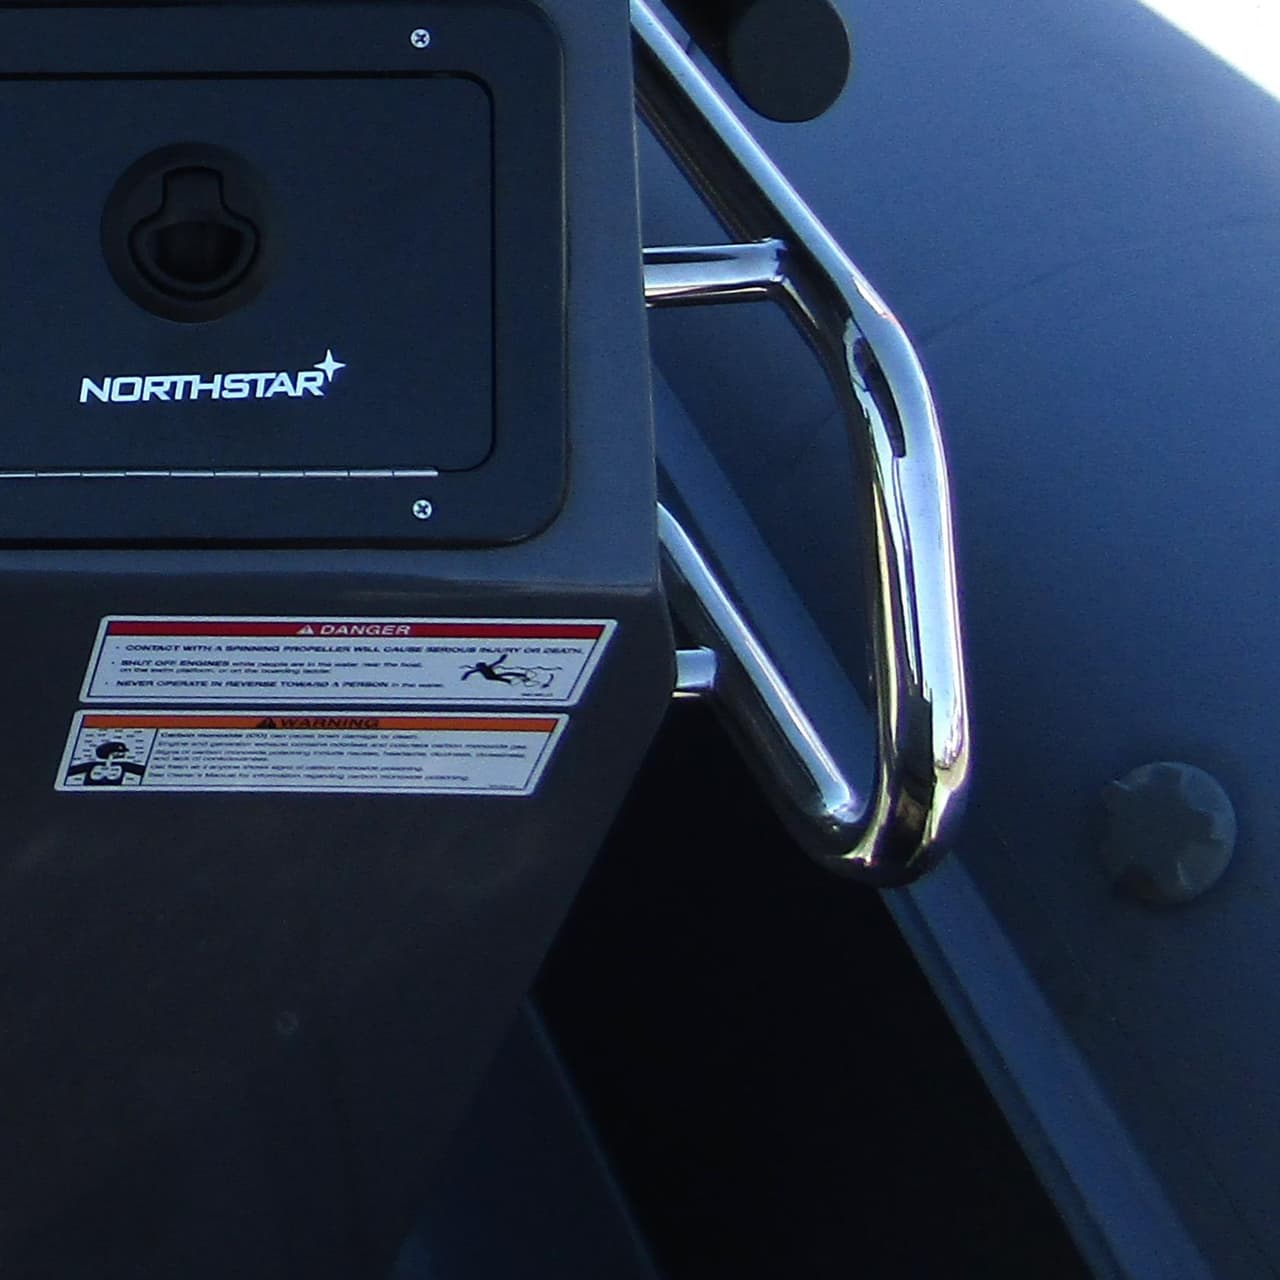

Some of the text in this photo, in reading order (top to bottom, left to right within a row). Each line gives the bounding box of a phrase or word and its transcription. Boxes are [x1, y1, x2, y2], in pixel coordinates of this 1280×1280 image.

[79, 371, 325, 403] NORTHSTAR
[320, 624, 411, 635] DANGER
[279, 718, 380, 728] WARNING
